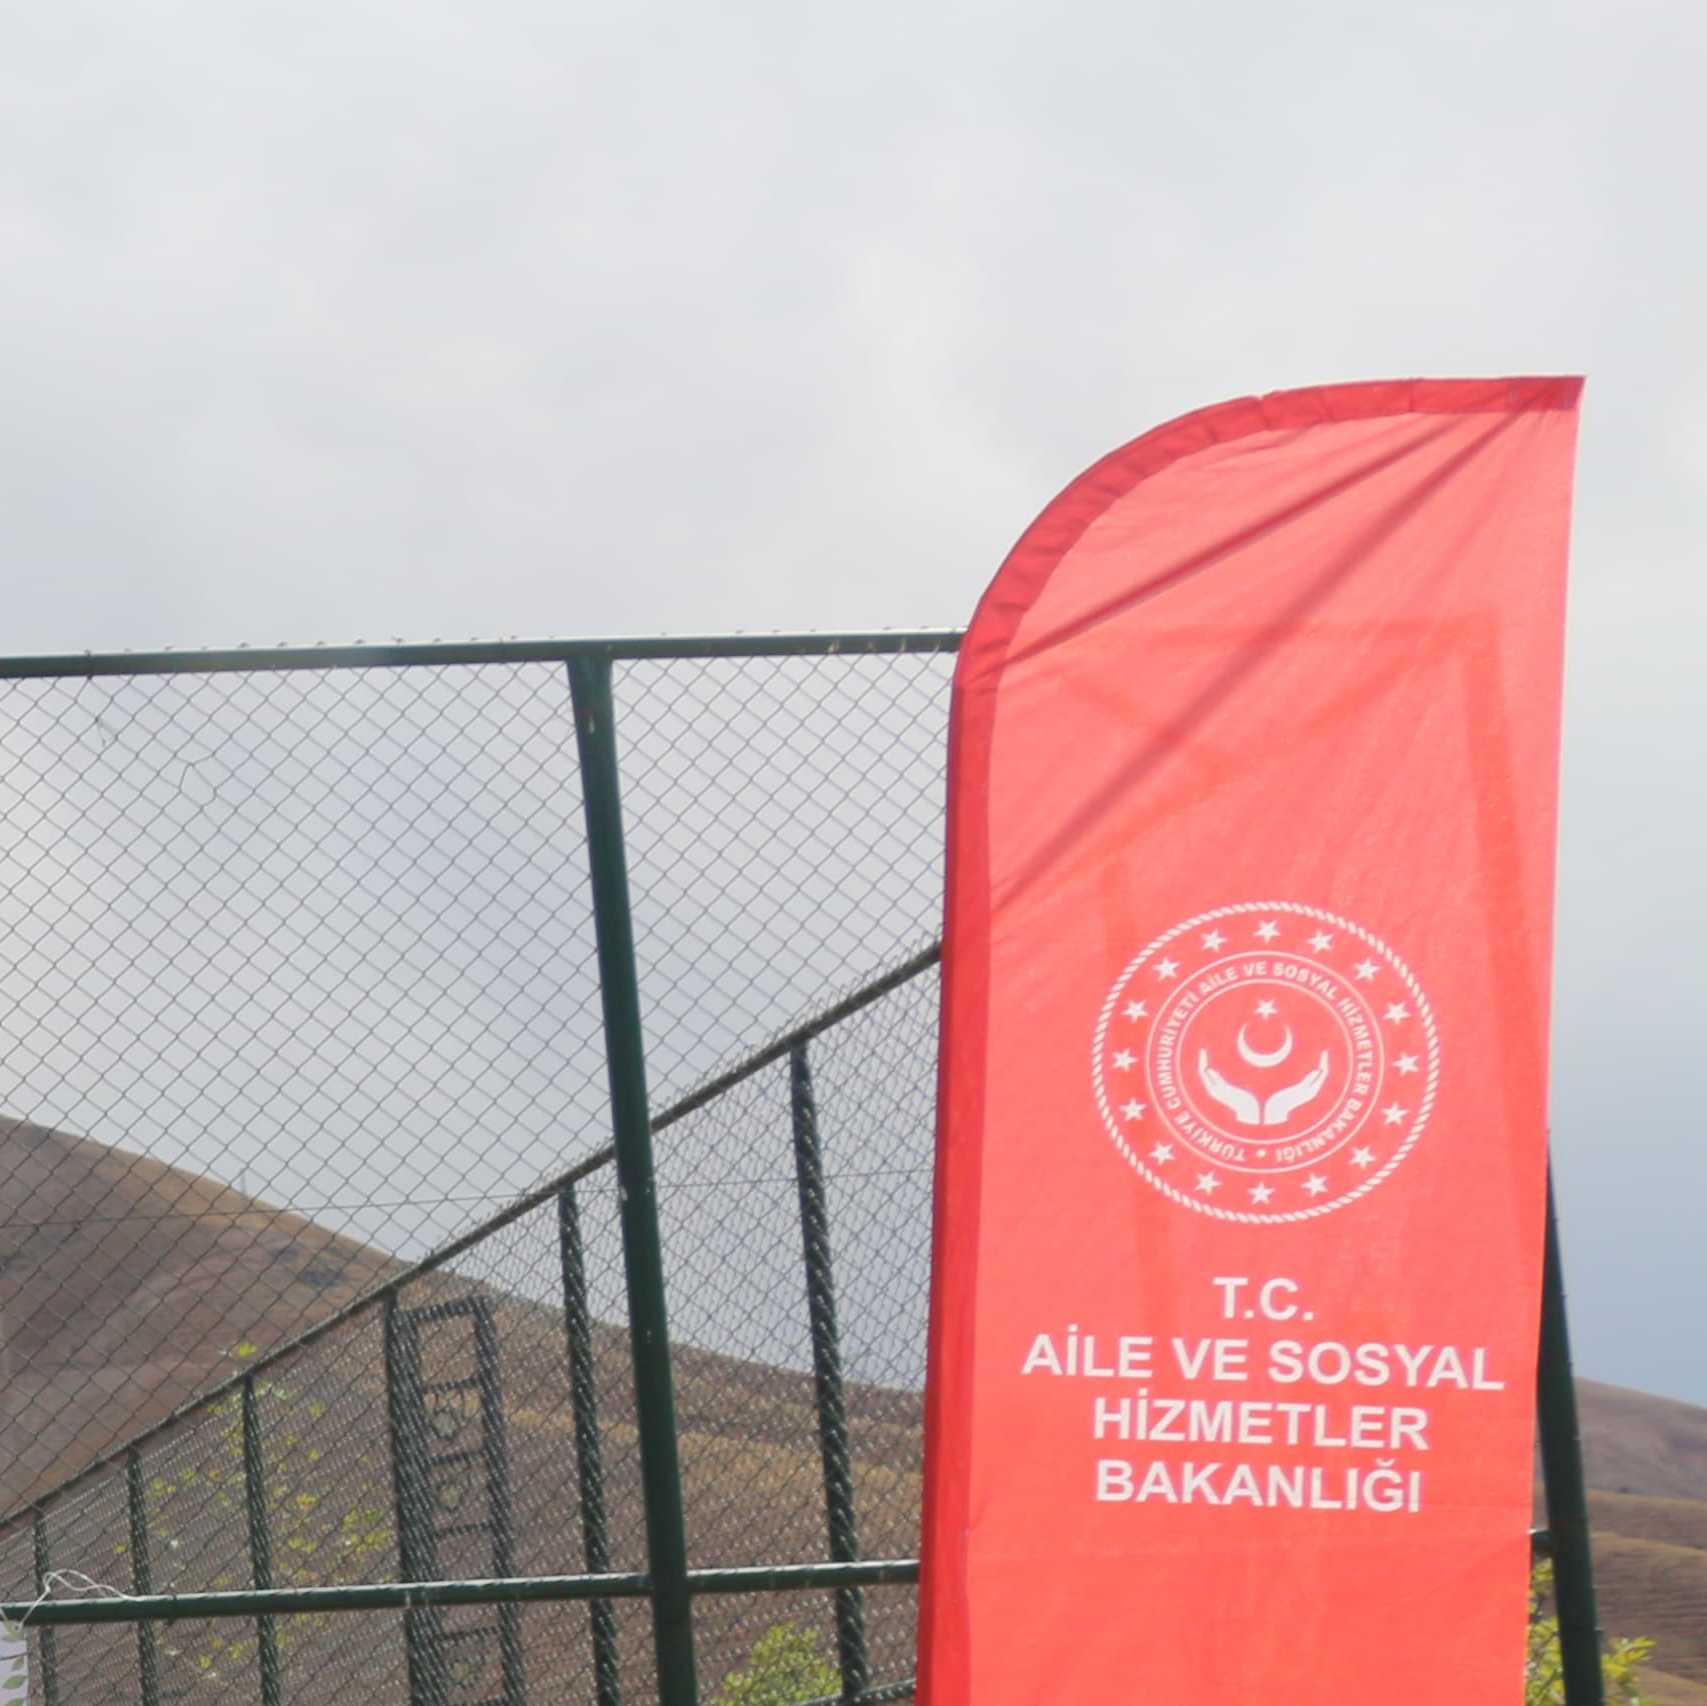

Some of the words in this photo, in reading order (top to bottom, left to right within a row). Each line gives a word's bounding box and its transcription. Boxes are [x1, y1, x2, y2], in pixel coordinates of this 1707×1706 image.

[1200, 964, 1238, 995] AİLE
[1243, 961, 1267, 976] VE
[1272, 961, 1336, 1000] SOSYAL
[1338, 997, 1373, 1094] HİZMETLER
[1212, 1276, 1315, 1321] T.C.
[1020, 1324, 1154, 1379] AİLE
[1171, 1336, 1250, 1382] VE
[1267, 1339, 1505, 1391] SOSYAL
[1093, 1387, 1430, 1450] HİZMETLER
[1096, 1457, 1421, 1513] BAKANLIĞI
